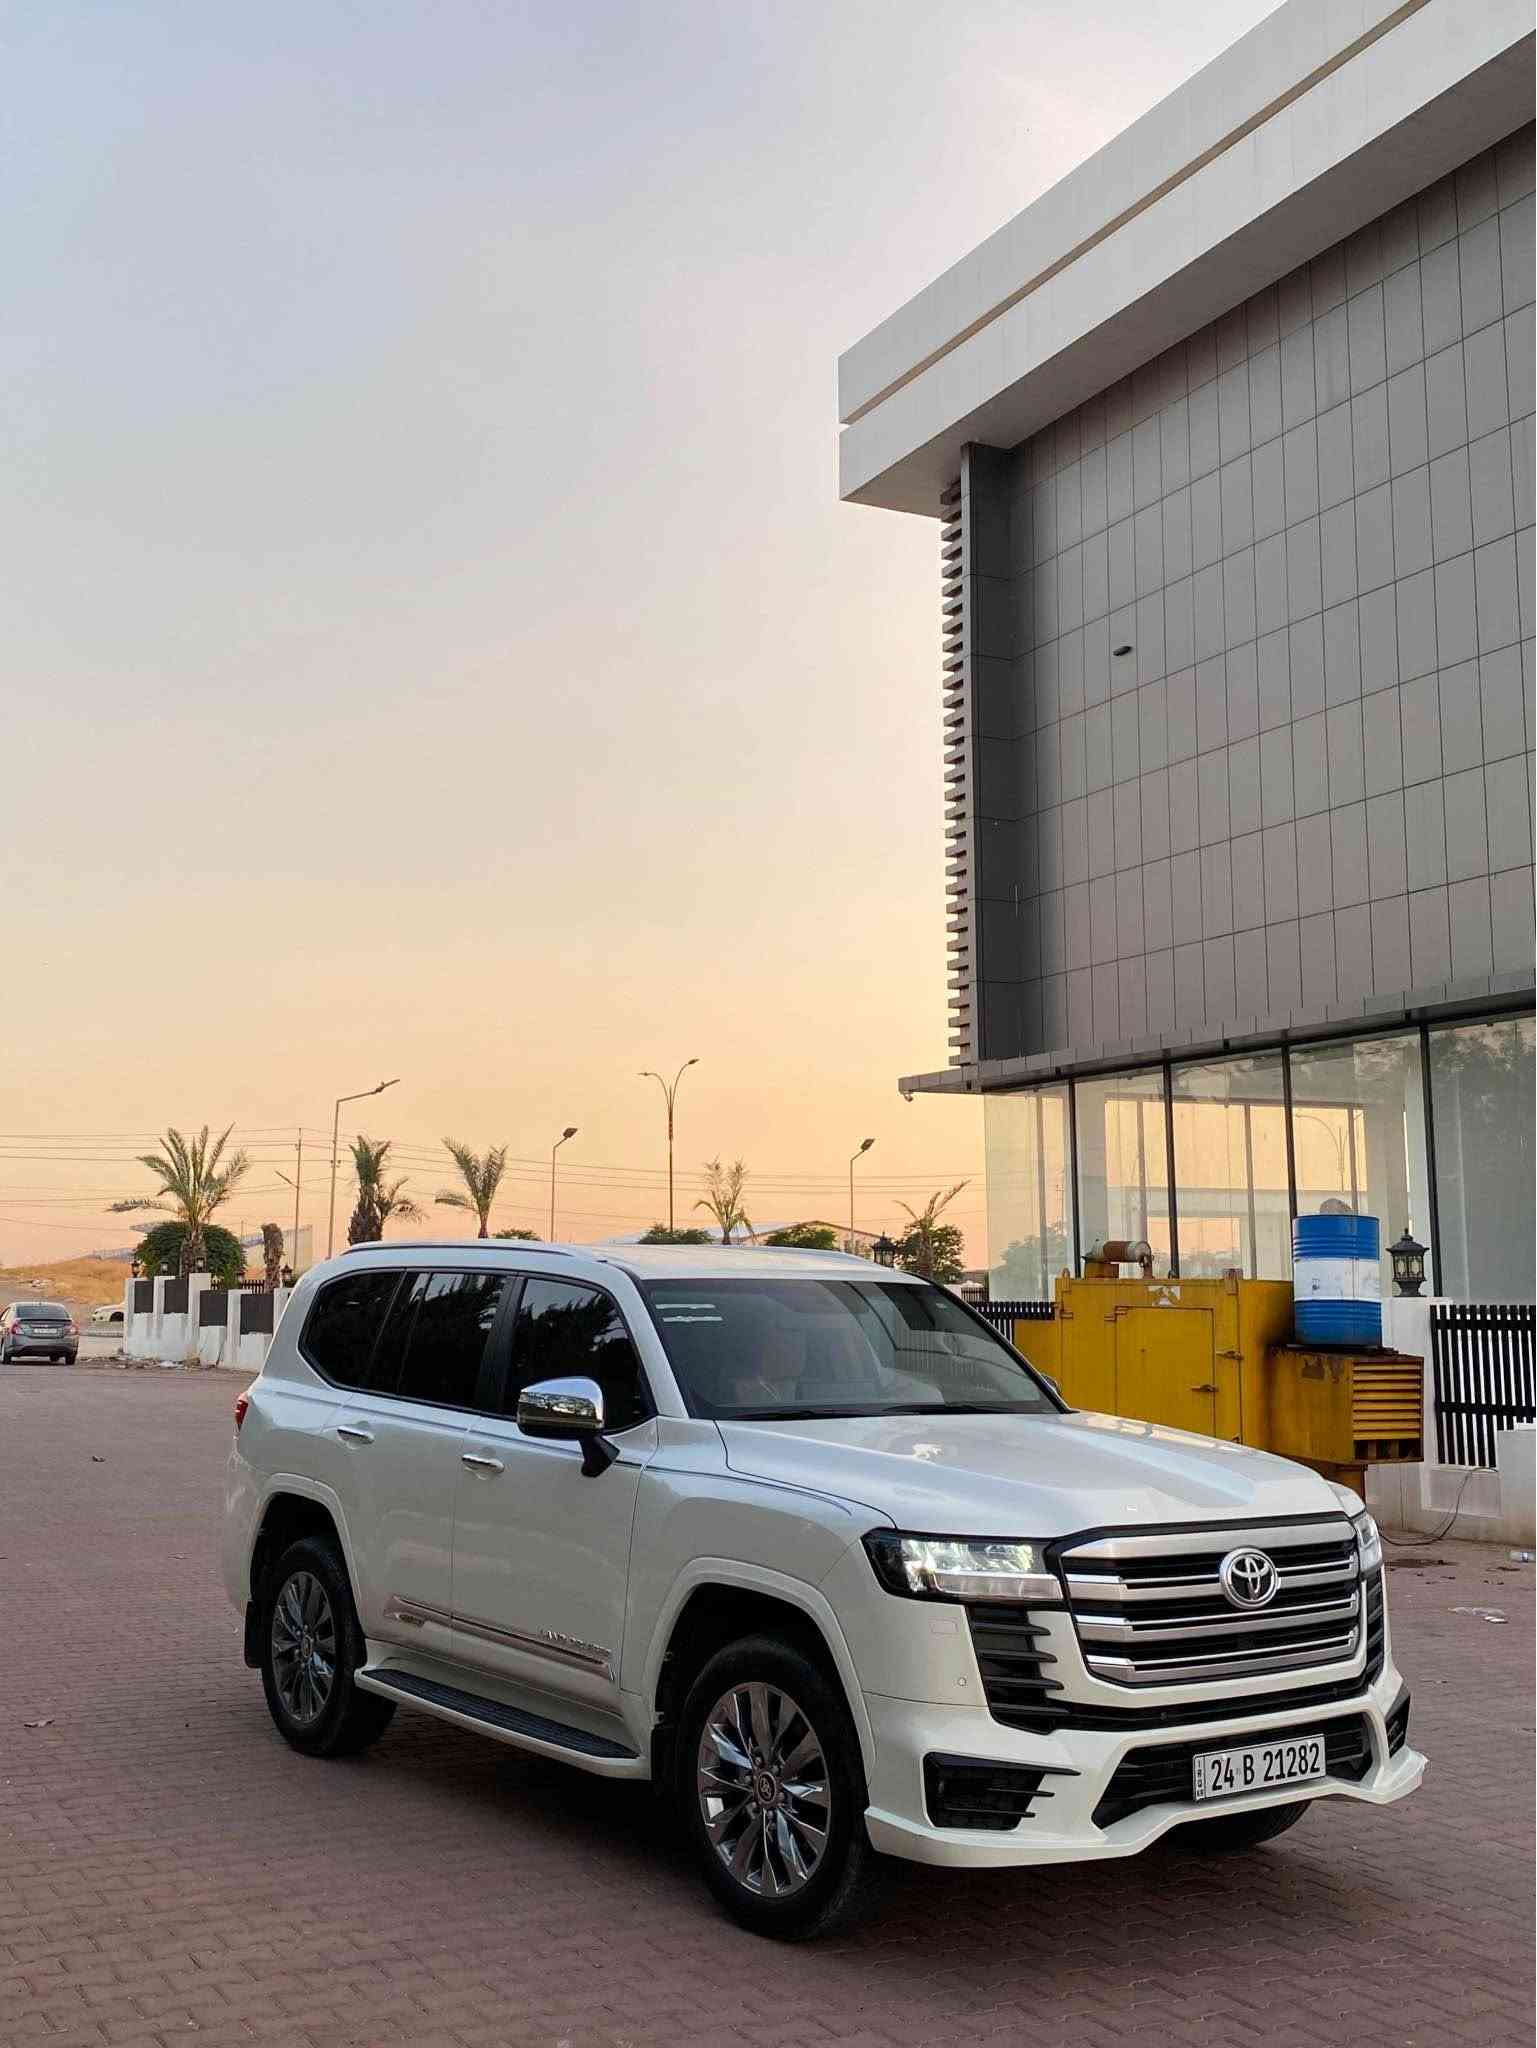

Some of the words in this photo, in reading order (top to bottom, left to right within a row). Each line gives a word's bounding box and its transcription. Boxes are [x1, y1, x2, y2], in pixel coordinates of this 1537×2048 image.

[1211, 1757, 1234, 1791] 24
[1243, 1754, 1255, 1785] B
[1263, 1742, 1320, 1782] 21282
